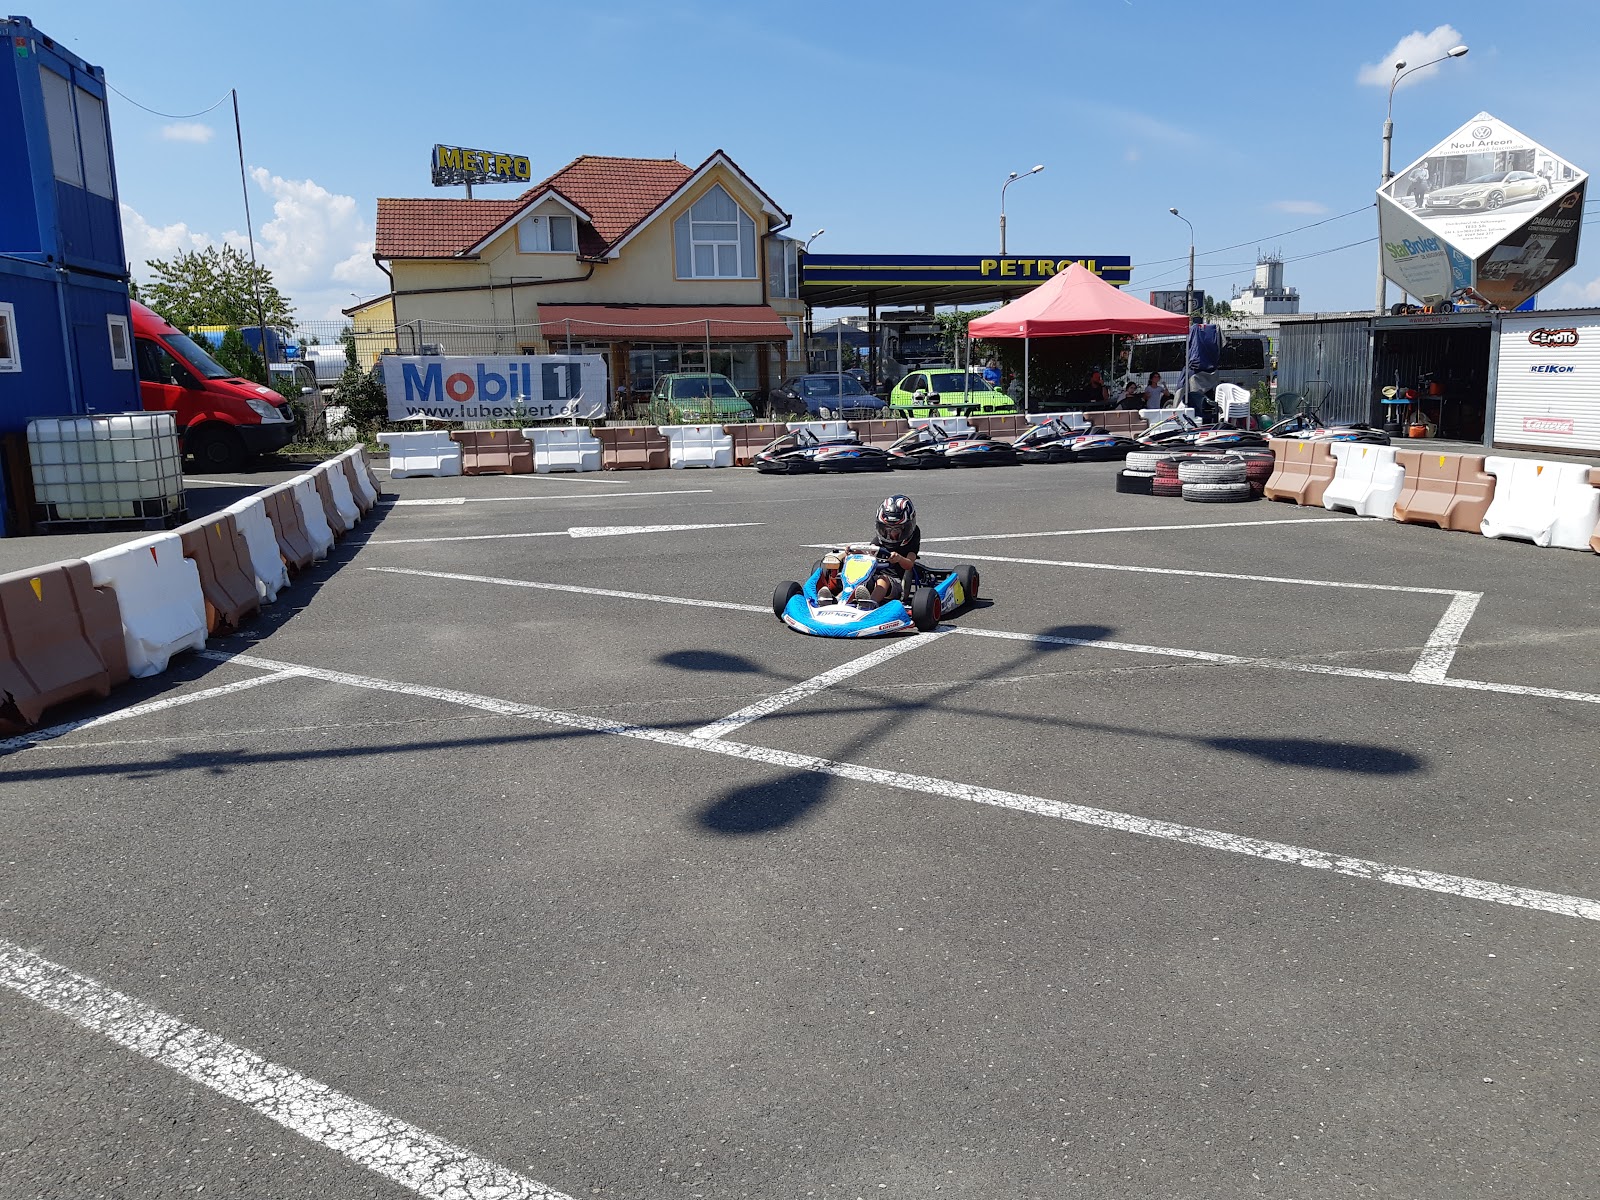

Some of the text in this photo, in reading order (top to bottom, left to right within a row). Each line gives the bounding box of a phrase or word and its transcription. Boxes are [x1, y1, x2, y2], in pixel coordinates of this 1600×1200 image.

[1451, 141, 1474, 149] Noul
[438, 147, 531, 179] METRO
[1385, 236, 1440, 258] StarBroker
[1530, 365, 1574, 374] REIKON
[402, 363, 531, 401] Mobil
[553, 365, 567, 399] 1
[406, 403, 580, 418] www.lubexpert.eu
